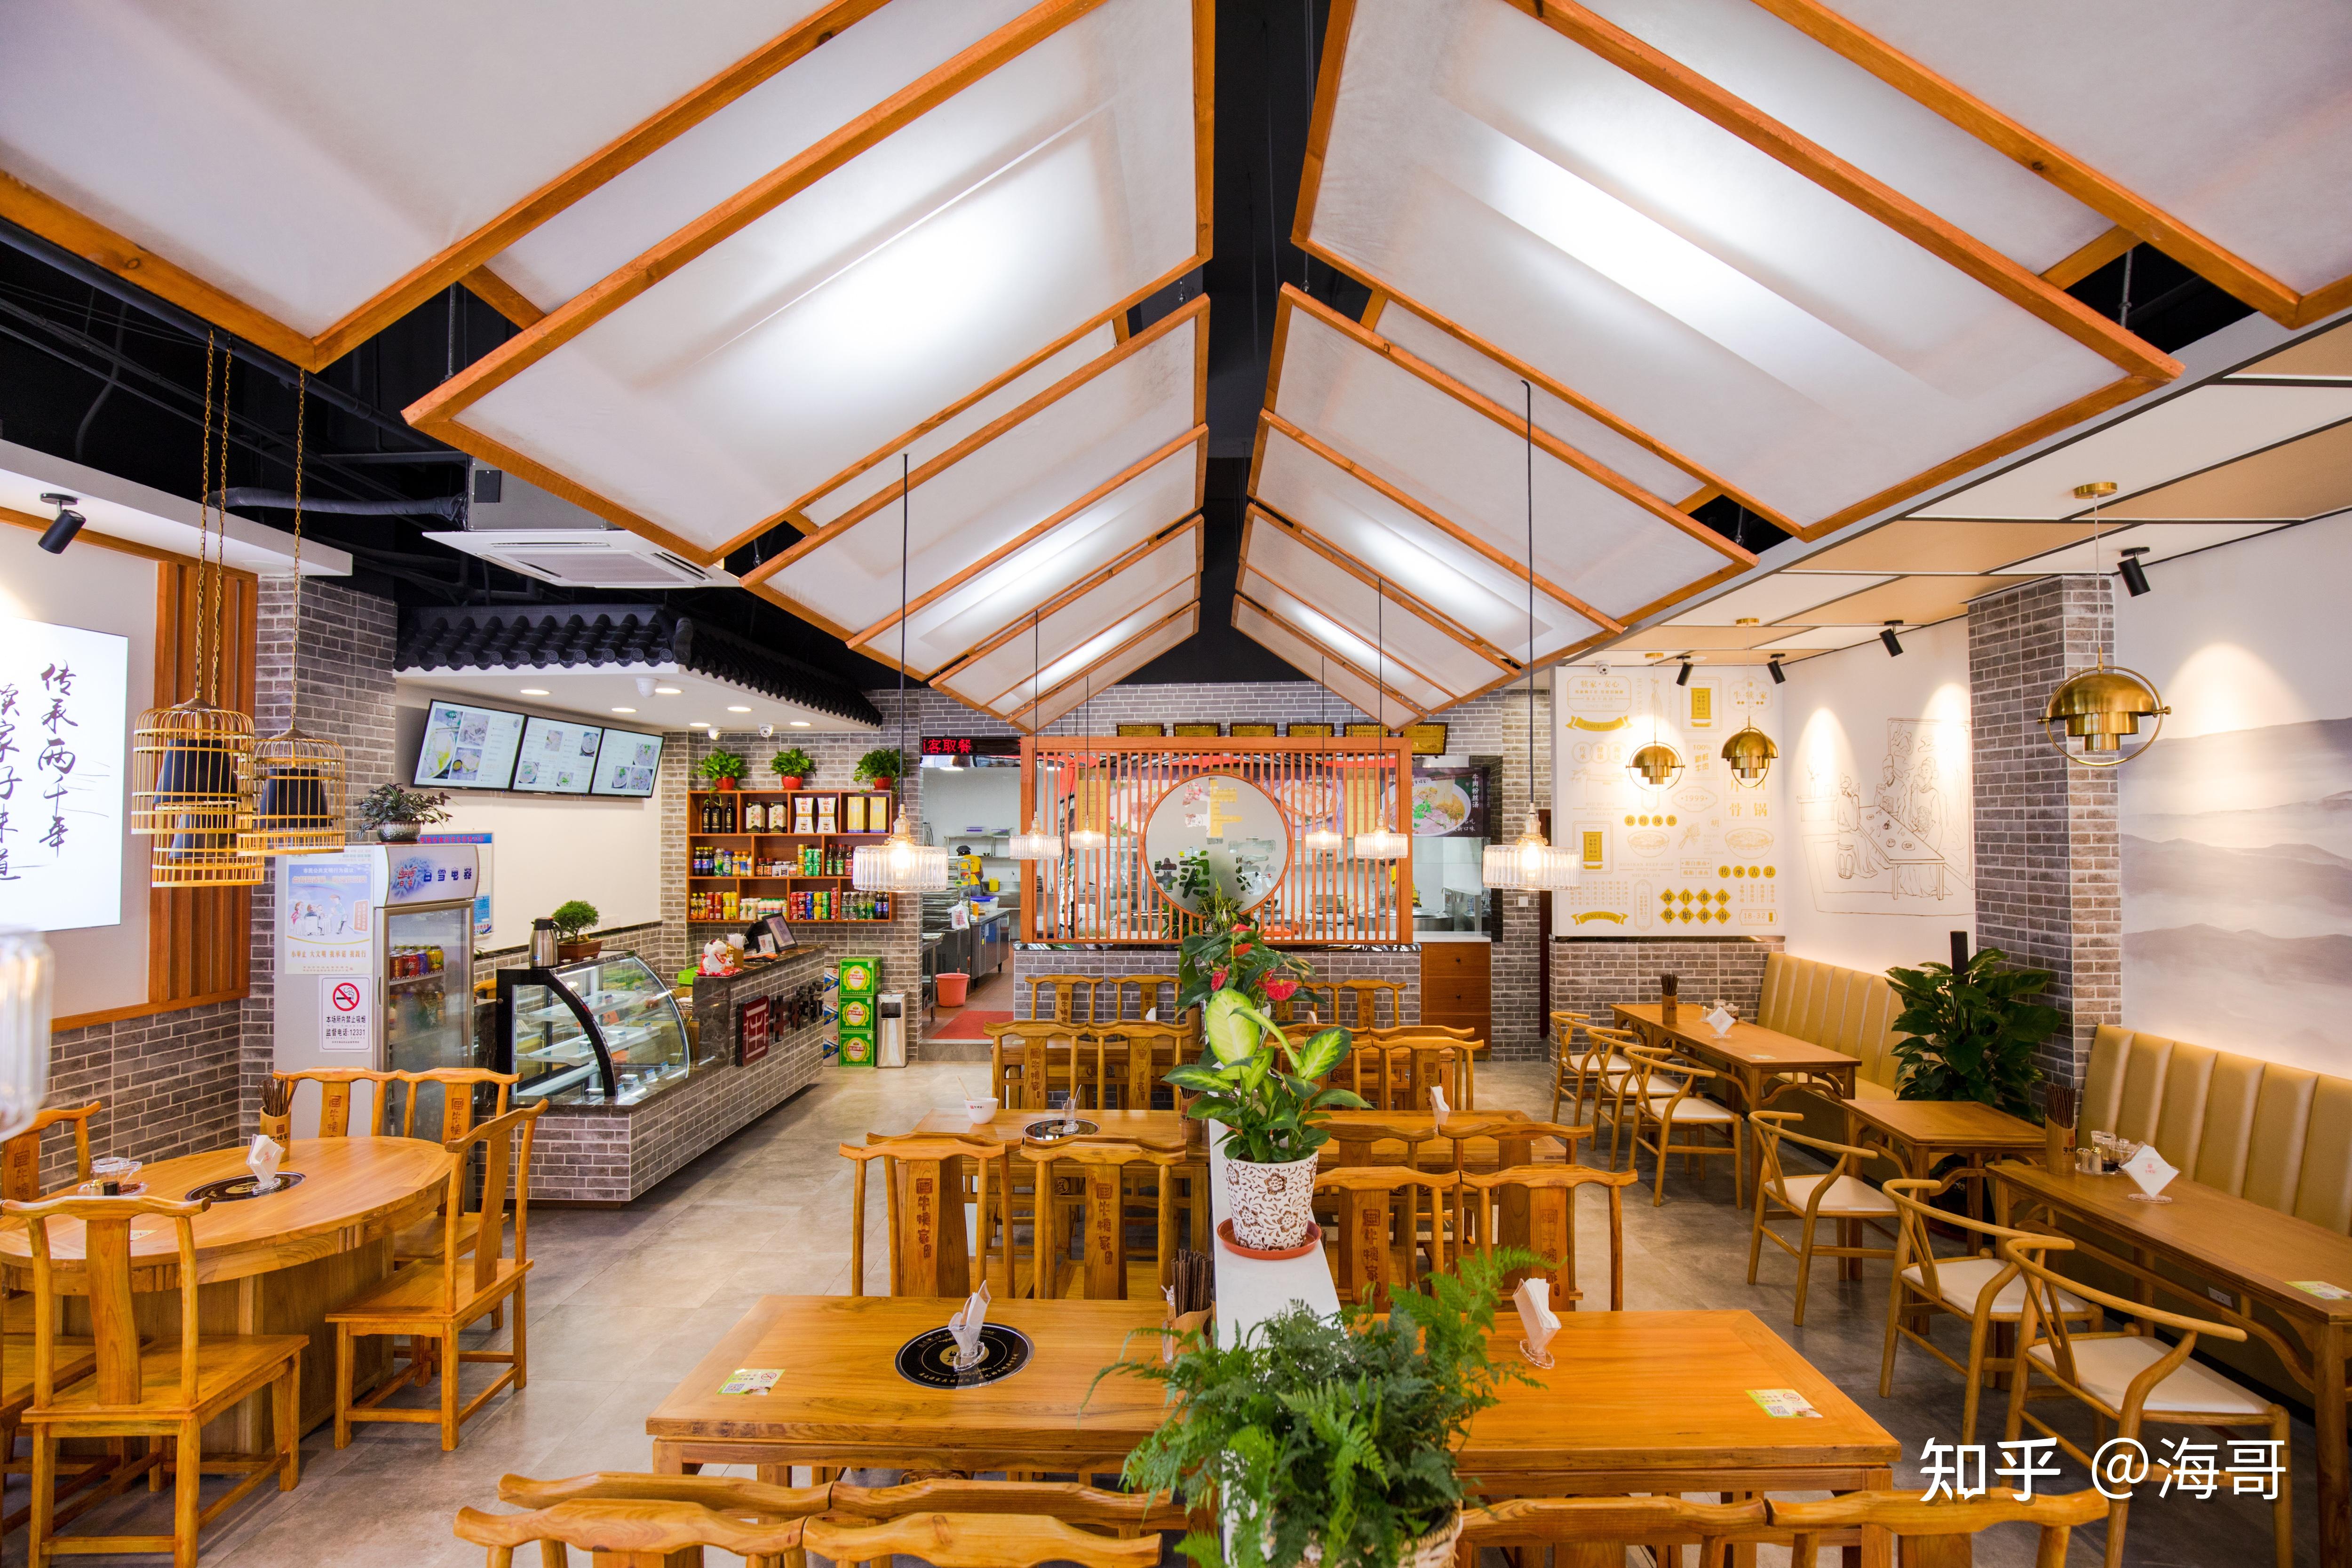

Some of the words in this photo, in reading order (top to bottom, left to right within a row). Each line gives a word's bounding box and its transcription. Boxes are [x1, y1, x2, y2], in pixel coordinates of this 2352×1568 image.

[923, 739, 971, 754] 客取餐
[38, 660, 79, 858] 传承两千年
[1694, 752, 1709, 763] 新鲜
[1695, 764, 1709, 772] 牛肉
[423, 866, 472, 882] 白雪电器
[1721, 868, 1773, 876] 传承古法
[1664, 892, 1726, 901] 源自淮南
[1664, 910, 1727, 920] 脱胎淮南
